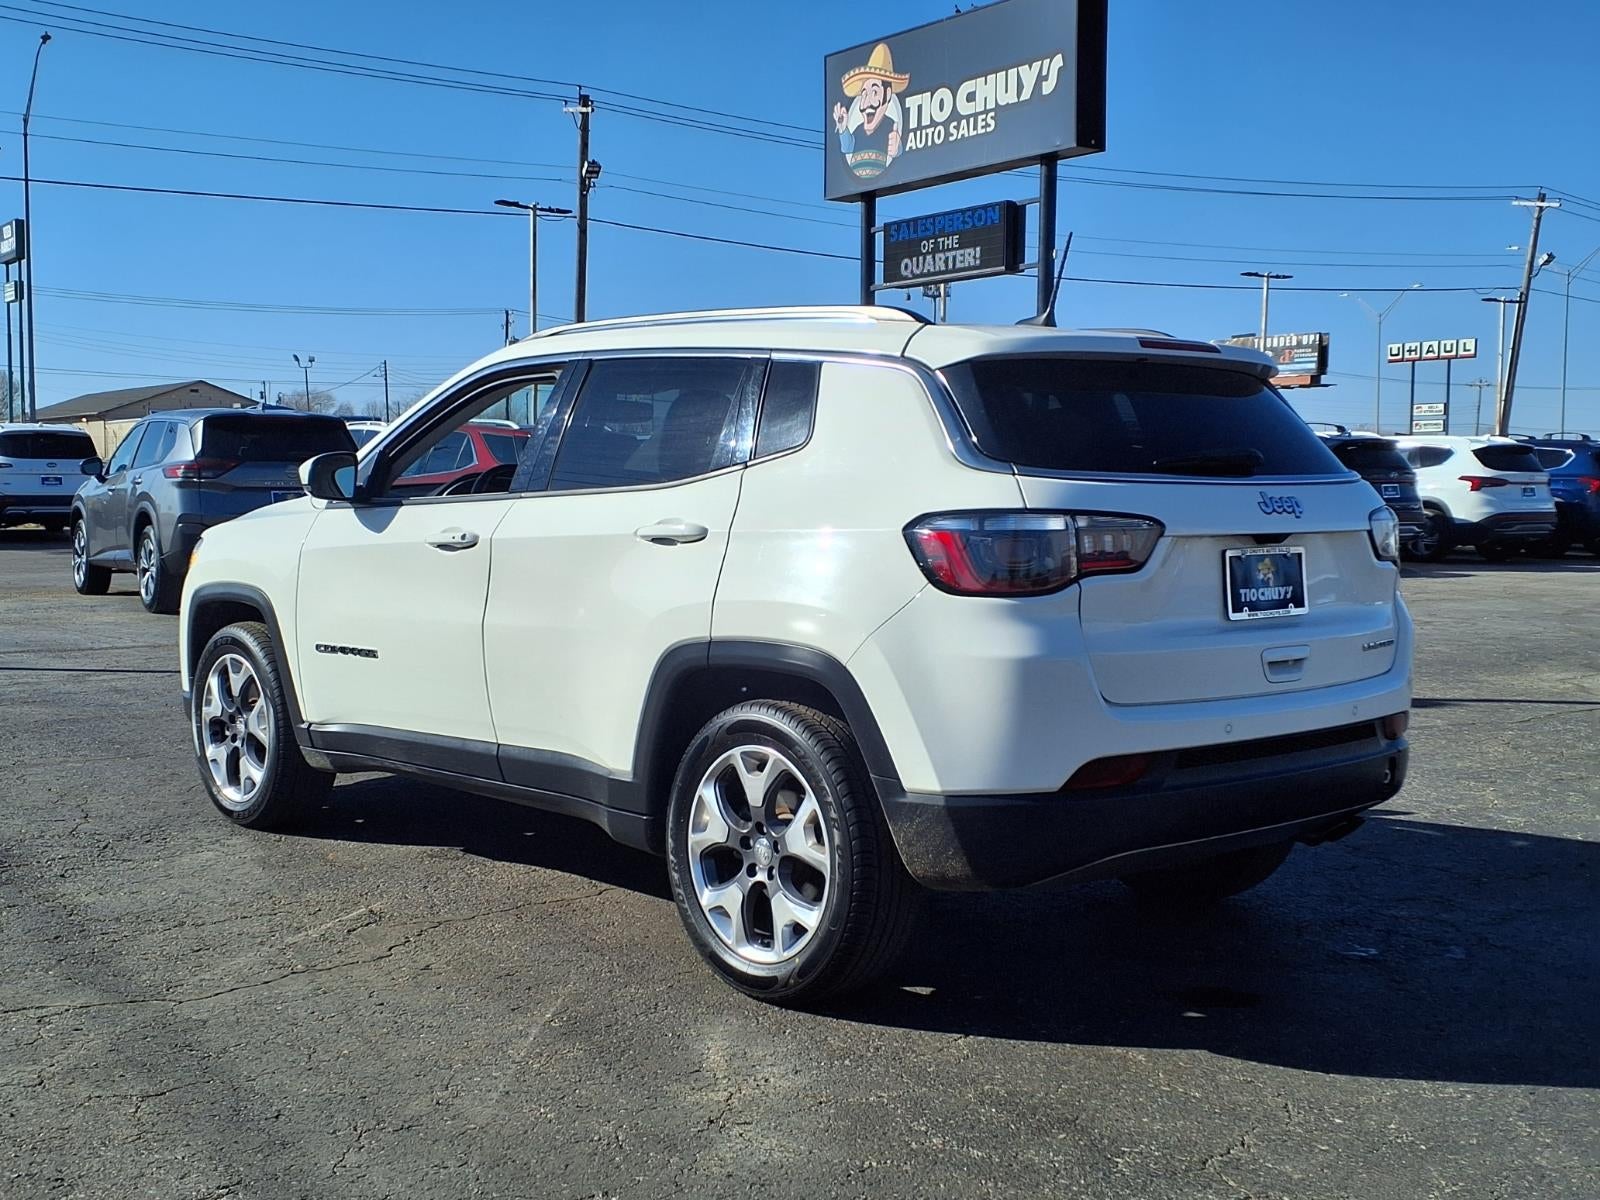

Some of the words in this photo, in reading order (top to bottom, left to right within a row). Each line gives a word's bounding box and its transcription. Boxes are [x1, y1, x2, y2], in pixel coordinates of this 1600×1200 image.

[905, 87, 953, 129] TIO
[956, 53, 1064, 116] CHUY'S
[905, 125, 945, 151] AUTO
[949, 112, 996, 141] SALES
[890, 205, 1000, 242] SALESPERSON
[920, 239, 935, 253] OF
[937, 235, 959, 249] THE
[900, 246, 981, 278] QUARTER!
[1302, 334, 1320, 345] UP!
[1257, 491, 1303, 518] Jeep
[1240, 588, 1257, 602] TIO
[1258, 585, 1293, 601] CHUY'S
